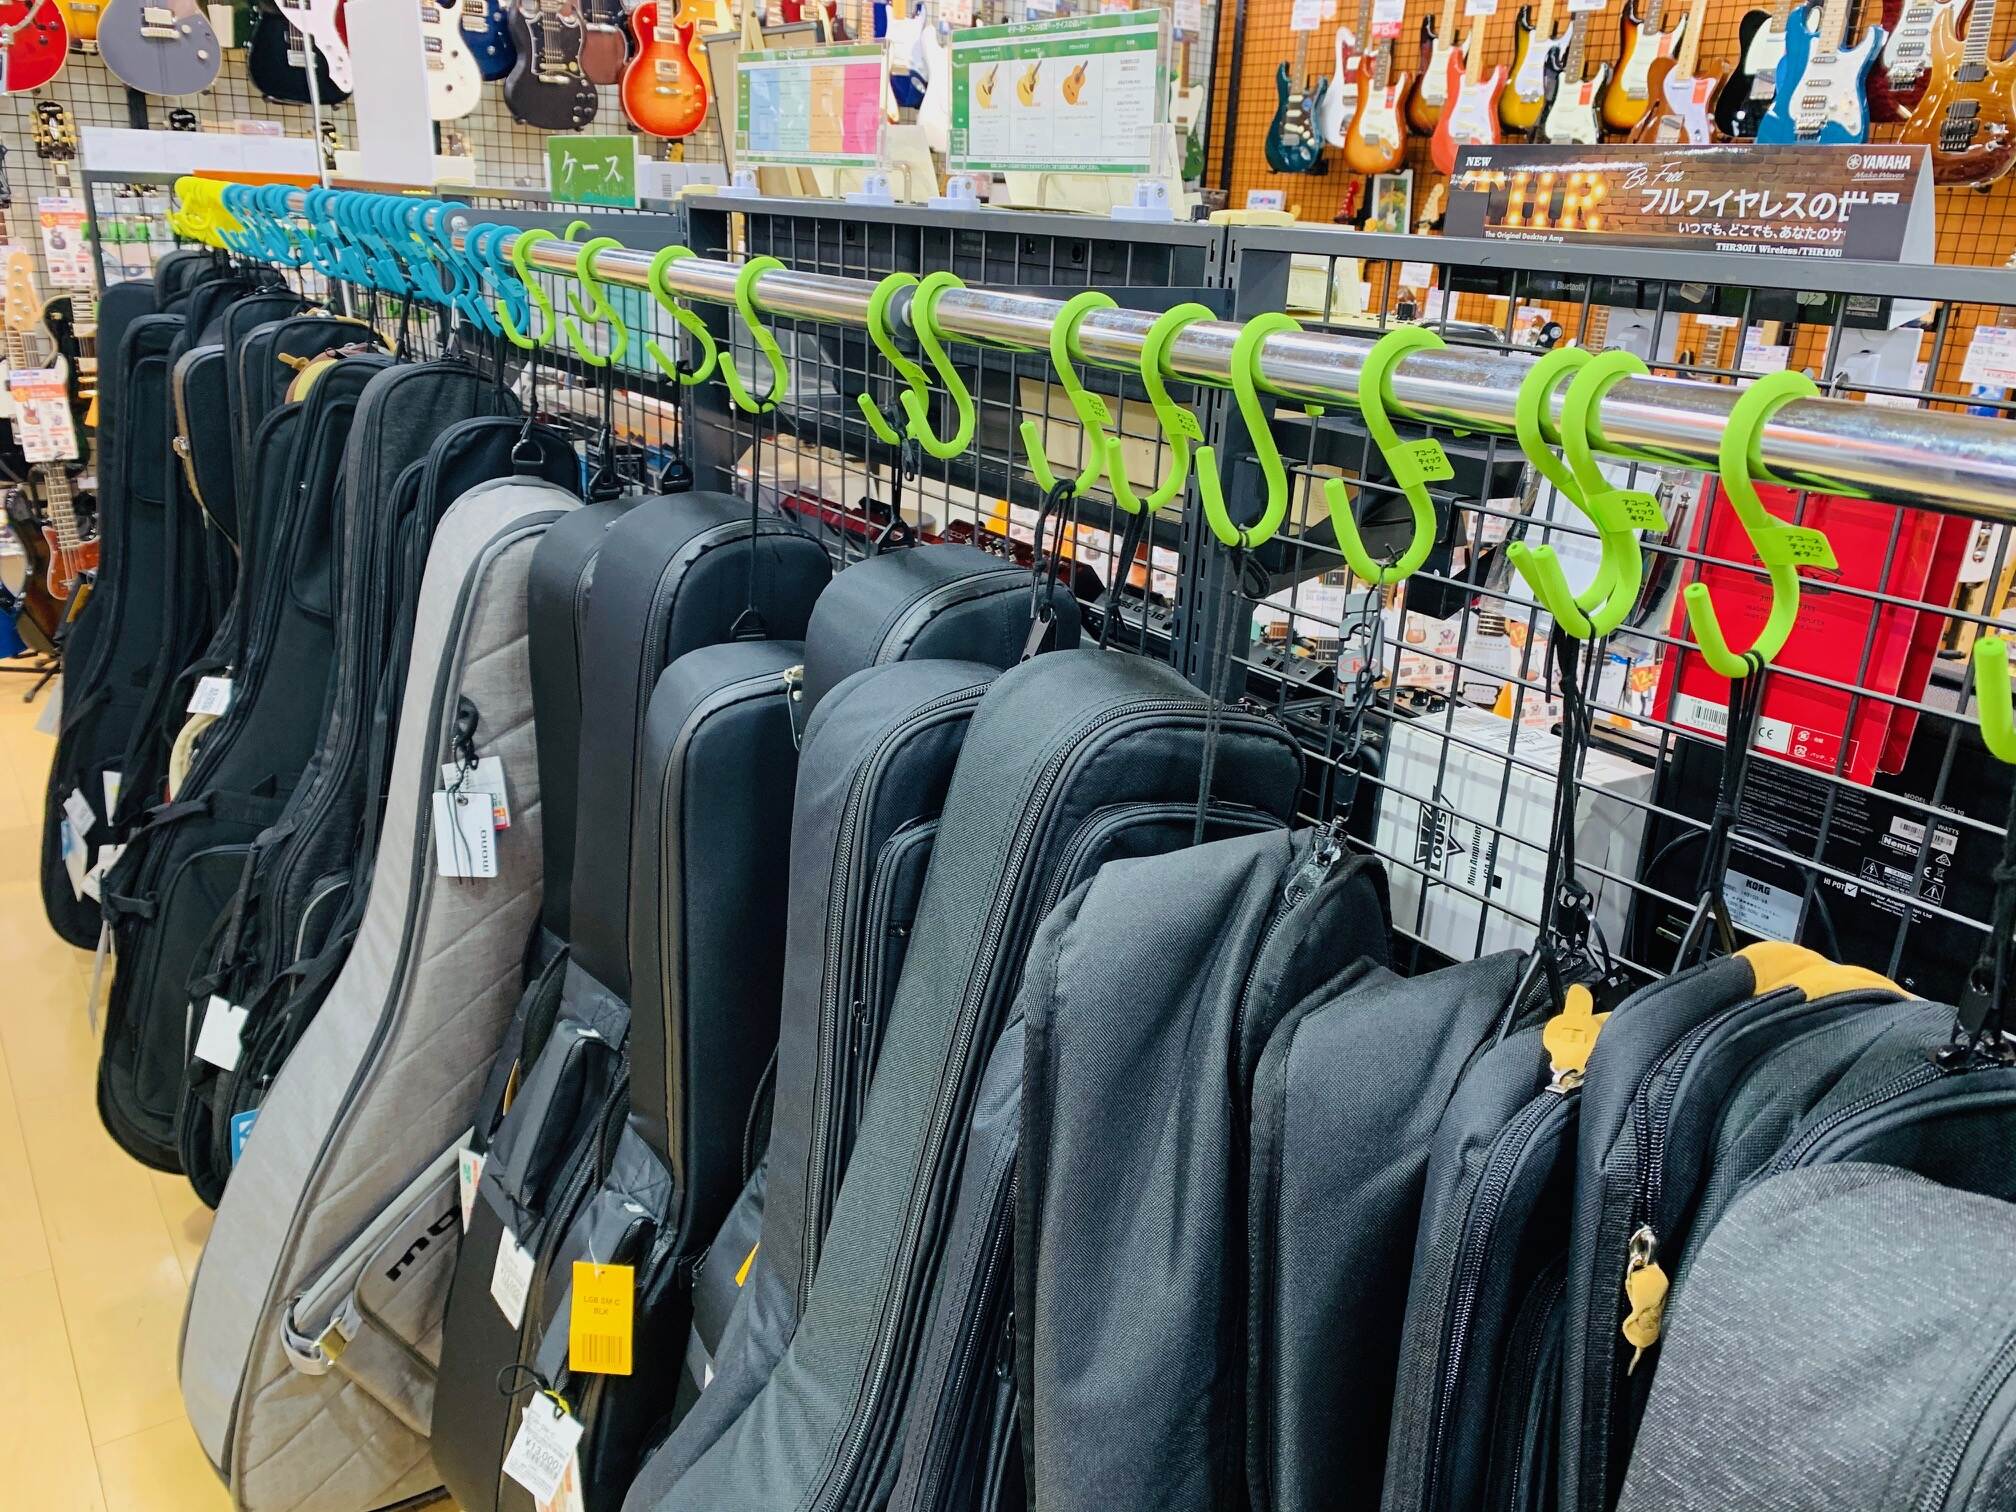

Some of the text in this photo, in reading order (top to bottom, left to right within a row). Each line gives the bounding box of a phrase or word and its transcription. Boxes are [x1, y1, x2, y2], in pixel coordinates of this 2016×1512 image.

[562, 150, 624, 184] ケース
[1465, 156, 1492, 167] NEW
[1862, 154, 1912, 170] YAMAHA
[1622, 161, 1685, 190] Be Free
[1485, 231, 1564, 244] The Original Desktop Amp
[1678, 221, 1846, 241] いつでも、どこでも、あなたのサ
[1937, 824, 1960, 836] WATTS
[1431, 810, 1447, 872] LOUIS
[1884, 837, 1917, 854] Nemko
[1467, 825, 1481, 886] Mini Amplifier
[1746, 879, 1771, 896] KORG
[1832, 880, 1846, 890] POT
